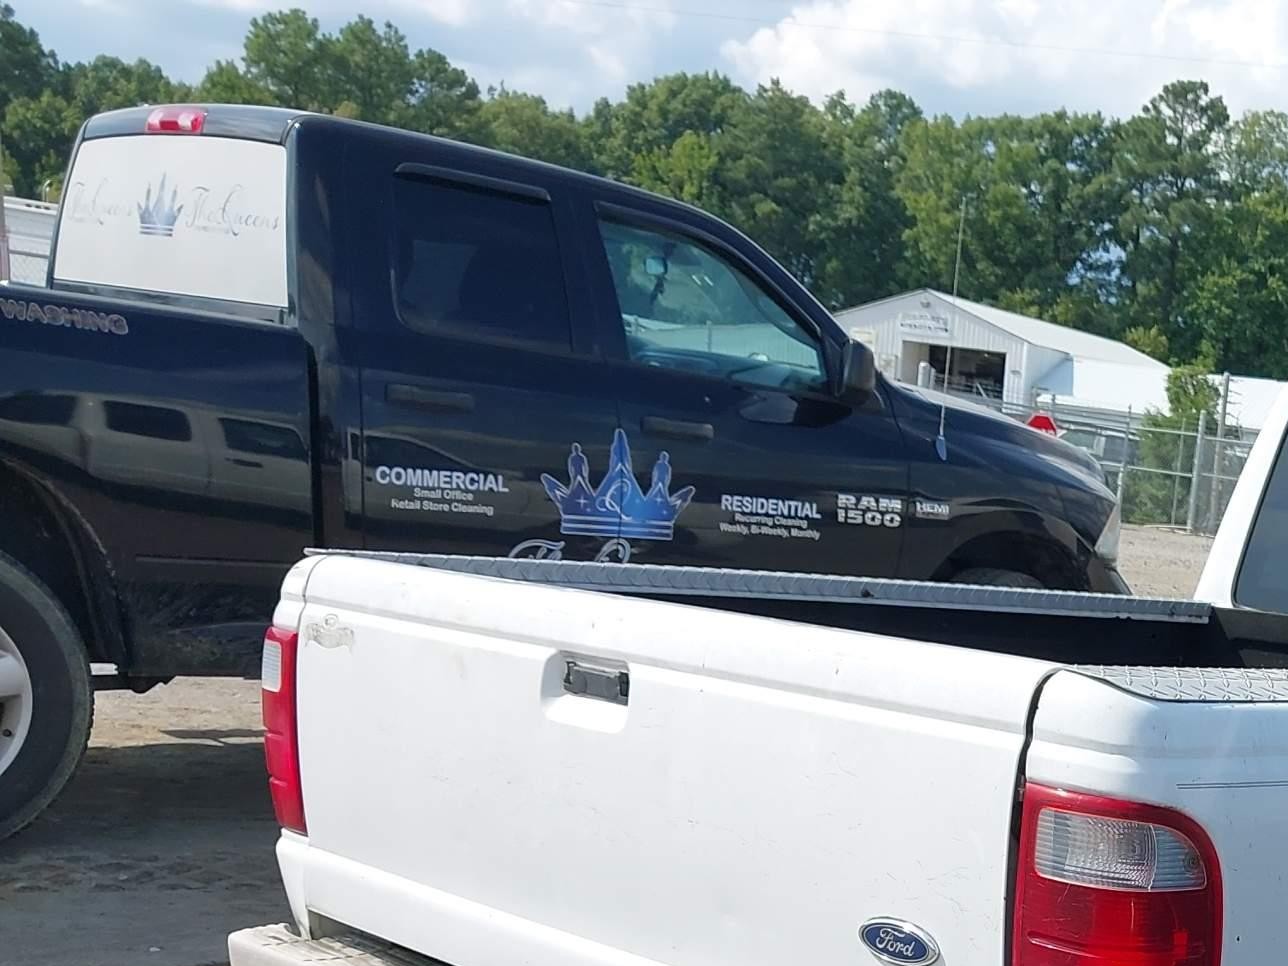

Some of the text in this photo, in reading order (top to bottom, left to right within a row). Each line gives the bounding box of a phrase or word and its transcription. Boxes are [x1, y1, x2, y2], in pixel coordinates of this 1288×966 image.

[376, 466, 509, 492] COMMERCIAL
[414, 488, 474, 501] Small Office
[837, 494, 902, 512] RAM
[391, 499, 494, 516] Retail Store Cleaning
[721, 495, 821, 519] RESIDENTIAL
[916, 501, 949, 514] HEMI
[734, 513, 808, 529] Recurring Cleaning
[837, 509, 901, 527] 1500
[719, 522, 749, 535] Weekly,
[791, 527, 821, 541] Monthly
[876, 928, 915, 957] Ford
